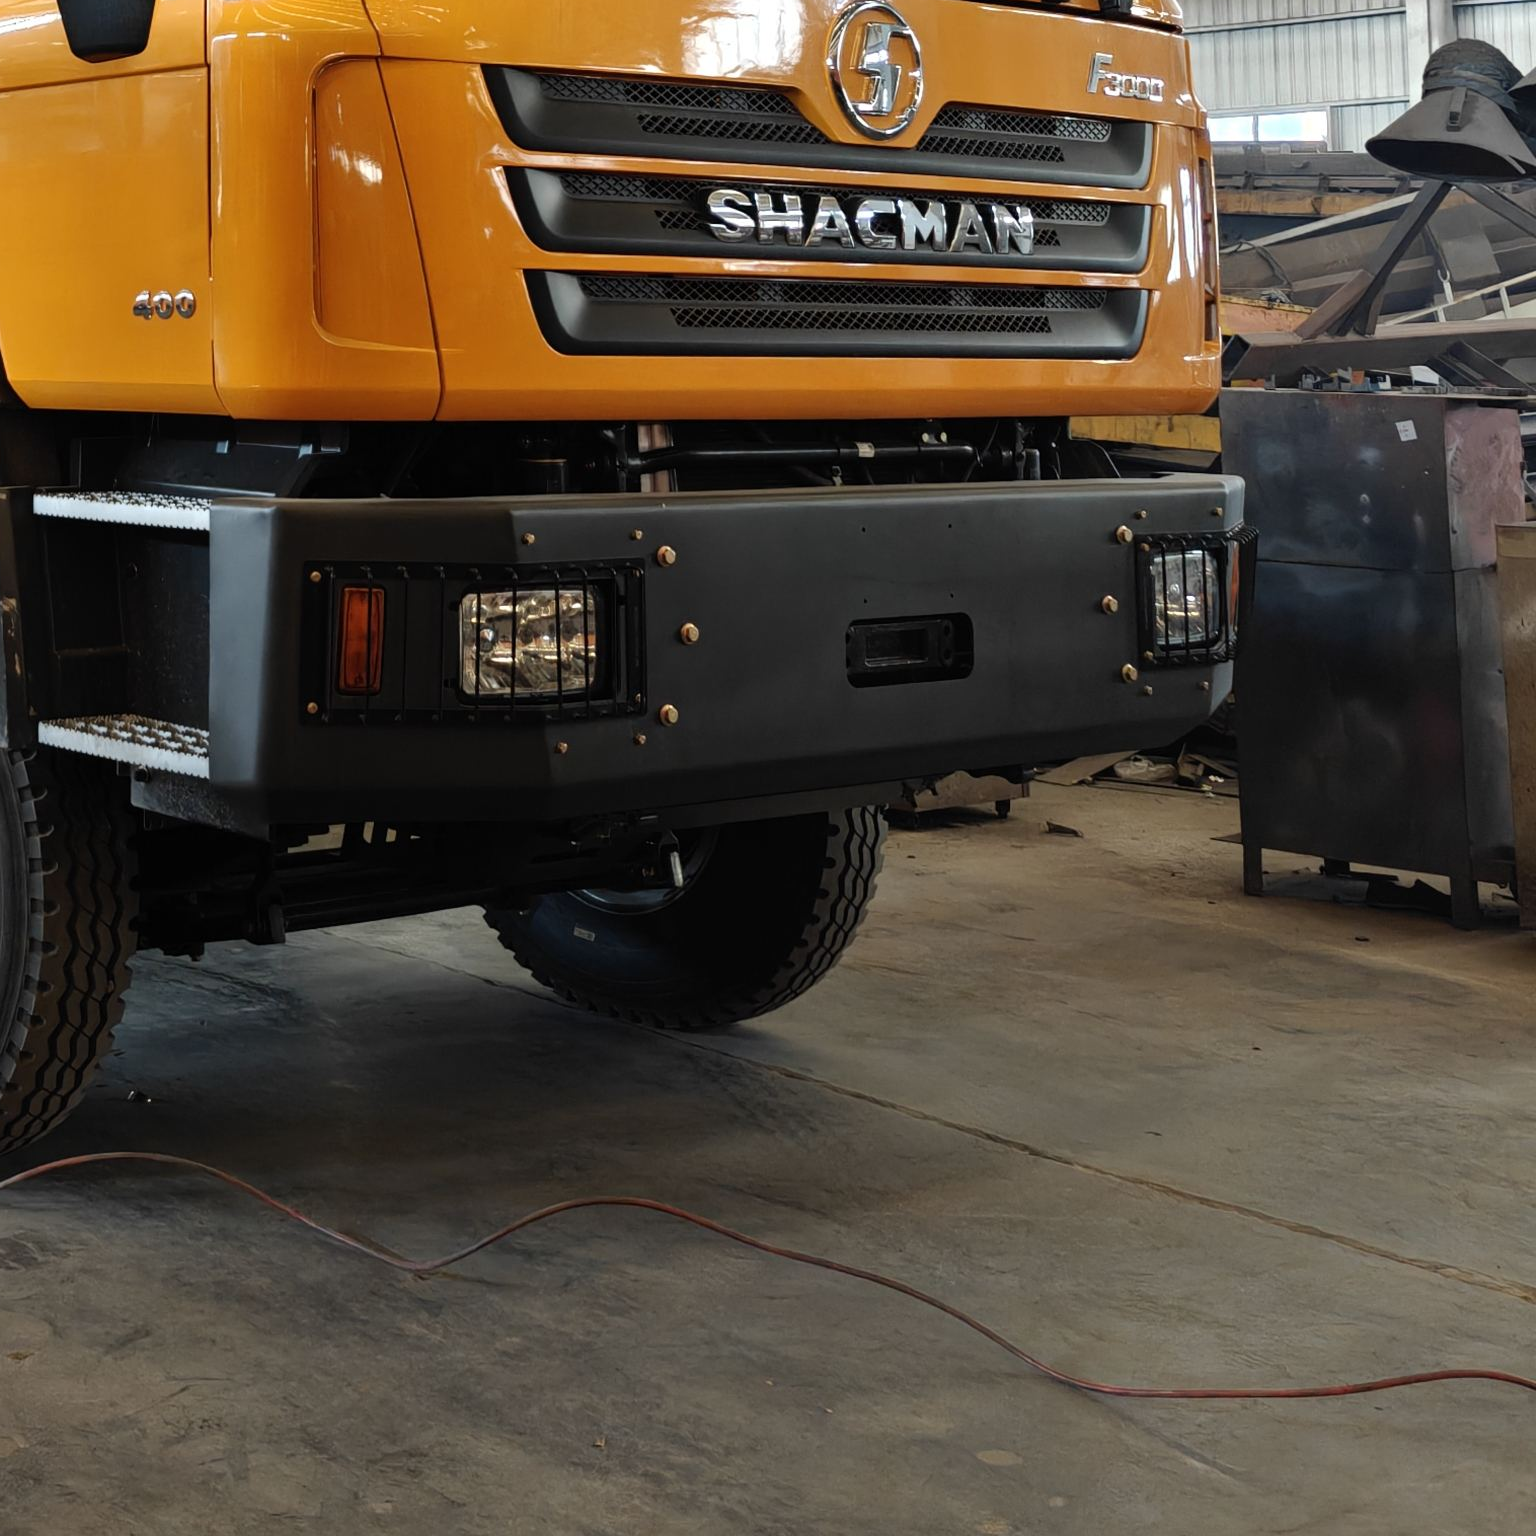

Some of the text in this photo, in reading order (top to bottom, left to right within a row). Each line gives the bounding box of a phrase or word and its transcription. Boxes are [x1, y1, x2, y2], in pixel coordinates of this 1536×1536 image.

[1087, 52, 1164, 102] F3000
[707, 189, 1035, 255] SHACMAN
[133, 289, 196, 320] 400
